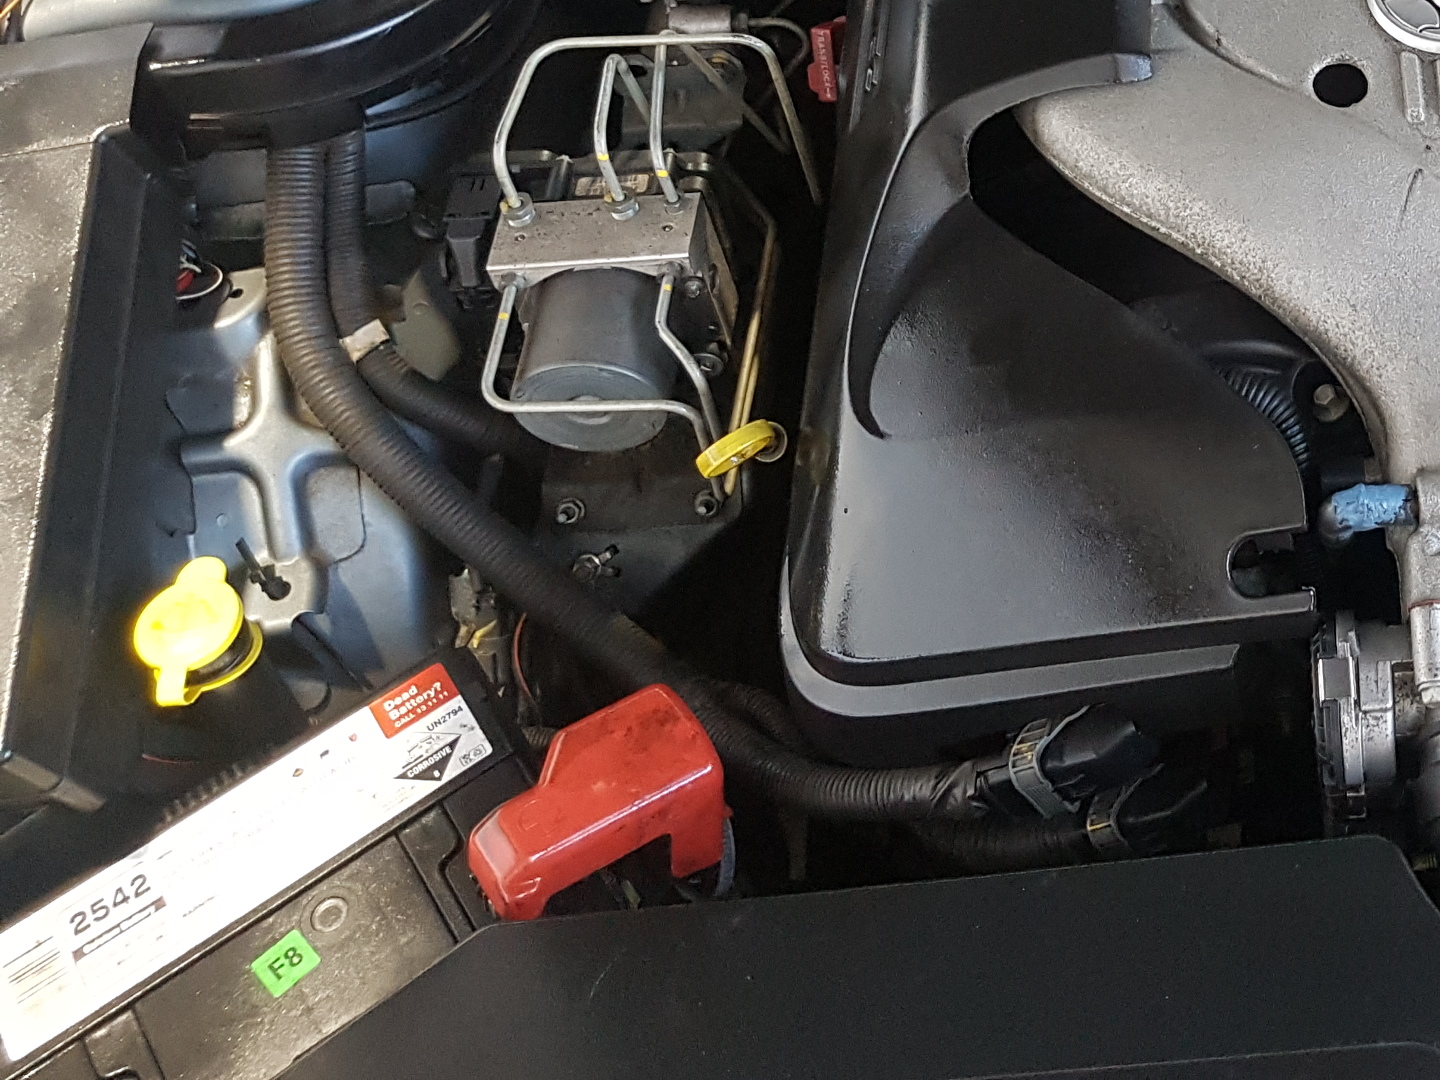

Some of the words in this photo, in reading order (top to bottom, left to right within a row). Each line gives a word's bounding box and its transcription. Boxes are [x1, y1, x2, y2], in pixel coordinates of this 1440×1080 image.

[383, 684, 418, 711] Dead
[388, 681, 442, 721] Battery?
[394, 712, 415, 727] CALL
[426, 705, 463, 731] UN2794
[407, 746, 453, 777] CORROSIVE
[69, 873, 151, 937] 2542
[266, 944, 305, 982] F8
